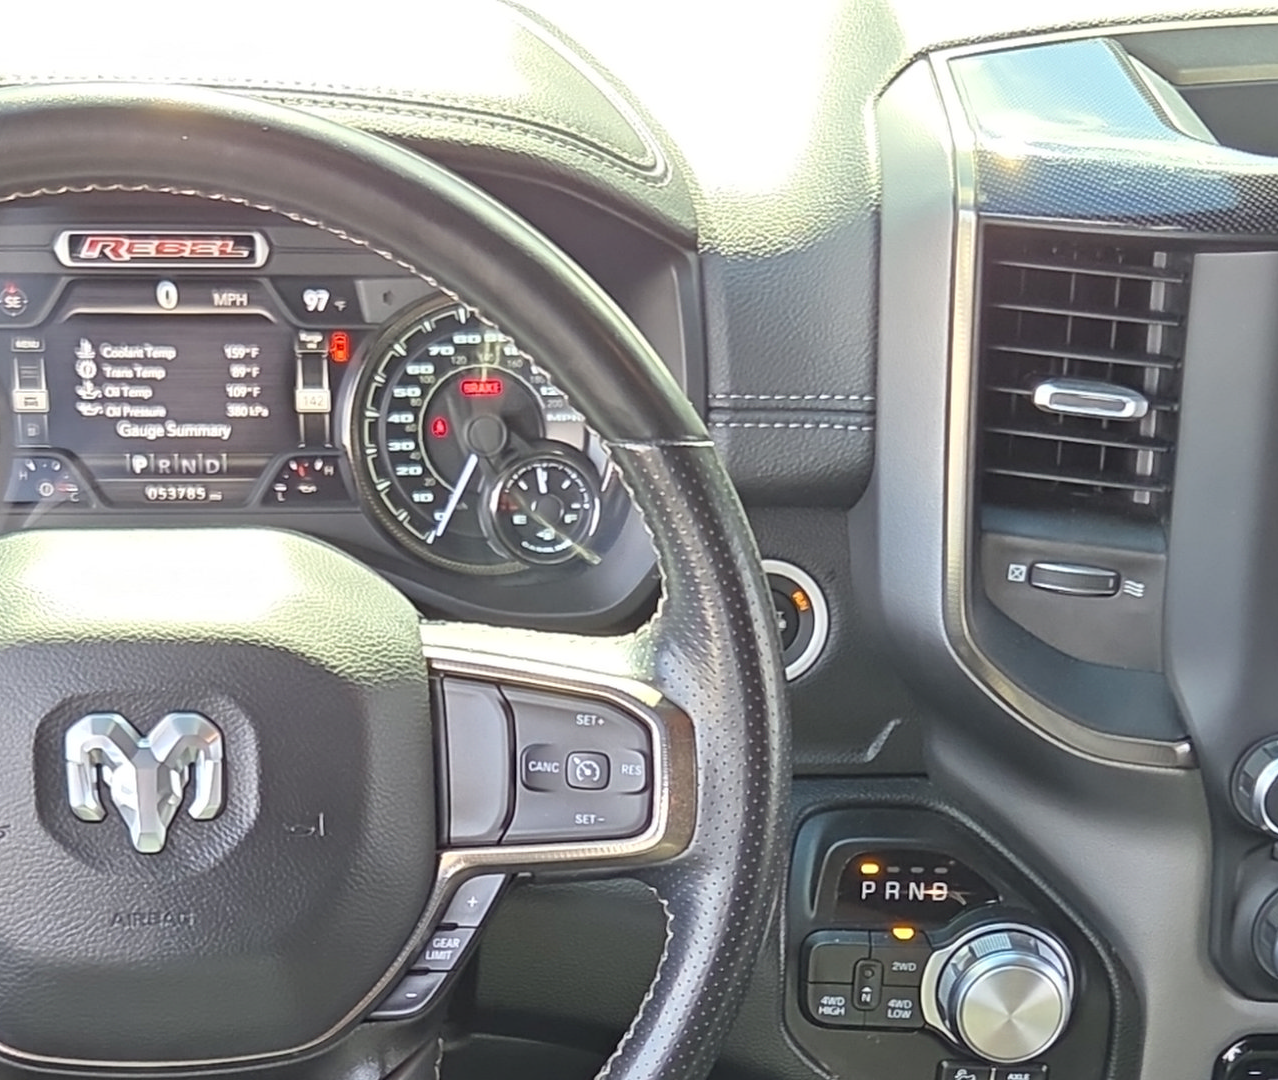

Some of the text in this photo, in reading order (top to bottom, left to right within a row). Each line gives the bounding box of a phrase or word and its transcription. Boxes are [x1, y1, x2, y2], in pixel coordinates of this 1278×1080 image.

[80, 236, 251, 261] REBEL
[156, 280, 248, 309] 0 MPH
[303, 289, 330, 311] 97
[100, 344, 177, 360] Coolant Temp
[428, 345, 455, 356] 70
[451, 356, 467, 365] 120
[102, 364, 166, 380] Trans Temp
[103, 384, 153, 399] Oil Temp
[393, 387, 421, 398] 50
[463, 382, 500, 394] BRAKE
[104, 404, 166, 418] Oil Pressure
[387, 413, 414, 424] 40
[116, 421, 232, 441] Gauge Summary
[388, 441, 415, 451] 30
[133, 455, 220, 473] P R N D
[396, 466, 422, 476] 20
[145, 485, 206, 500] 053785
[412, 493, 434, 503] 10
[513, 515, 527, 525] E
[564, 513, 578, 523] F
[528, 761, 559, 773] CANC
[621, 763, 642, 776] RES
[862, 882, 948, 900] P R N D
[433, 938, 460, 948] GEAR
[425, 950, 454, 961] LIMIT
[891, 961, 917, 972] 2WD
[820, 995, 845, 1006] 4WD
[861, 993, 871, 1003] N
[887, 999, 913, 1009] 4WD
[818, 1005, 845, 1016] HIGH
[887, 1009, 912, 1019] LOW
[1007, 1073, 1030, 1080] AXLE
